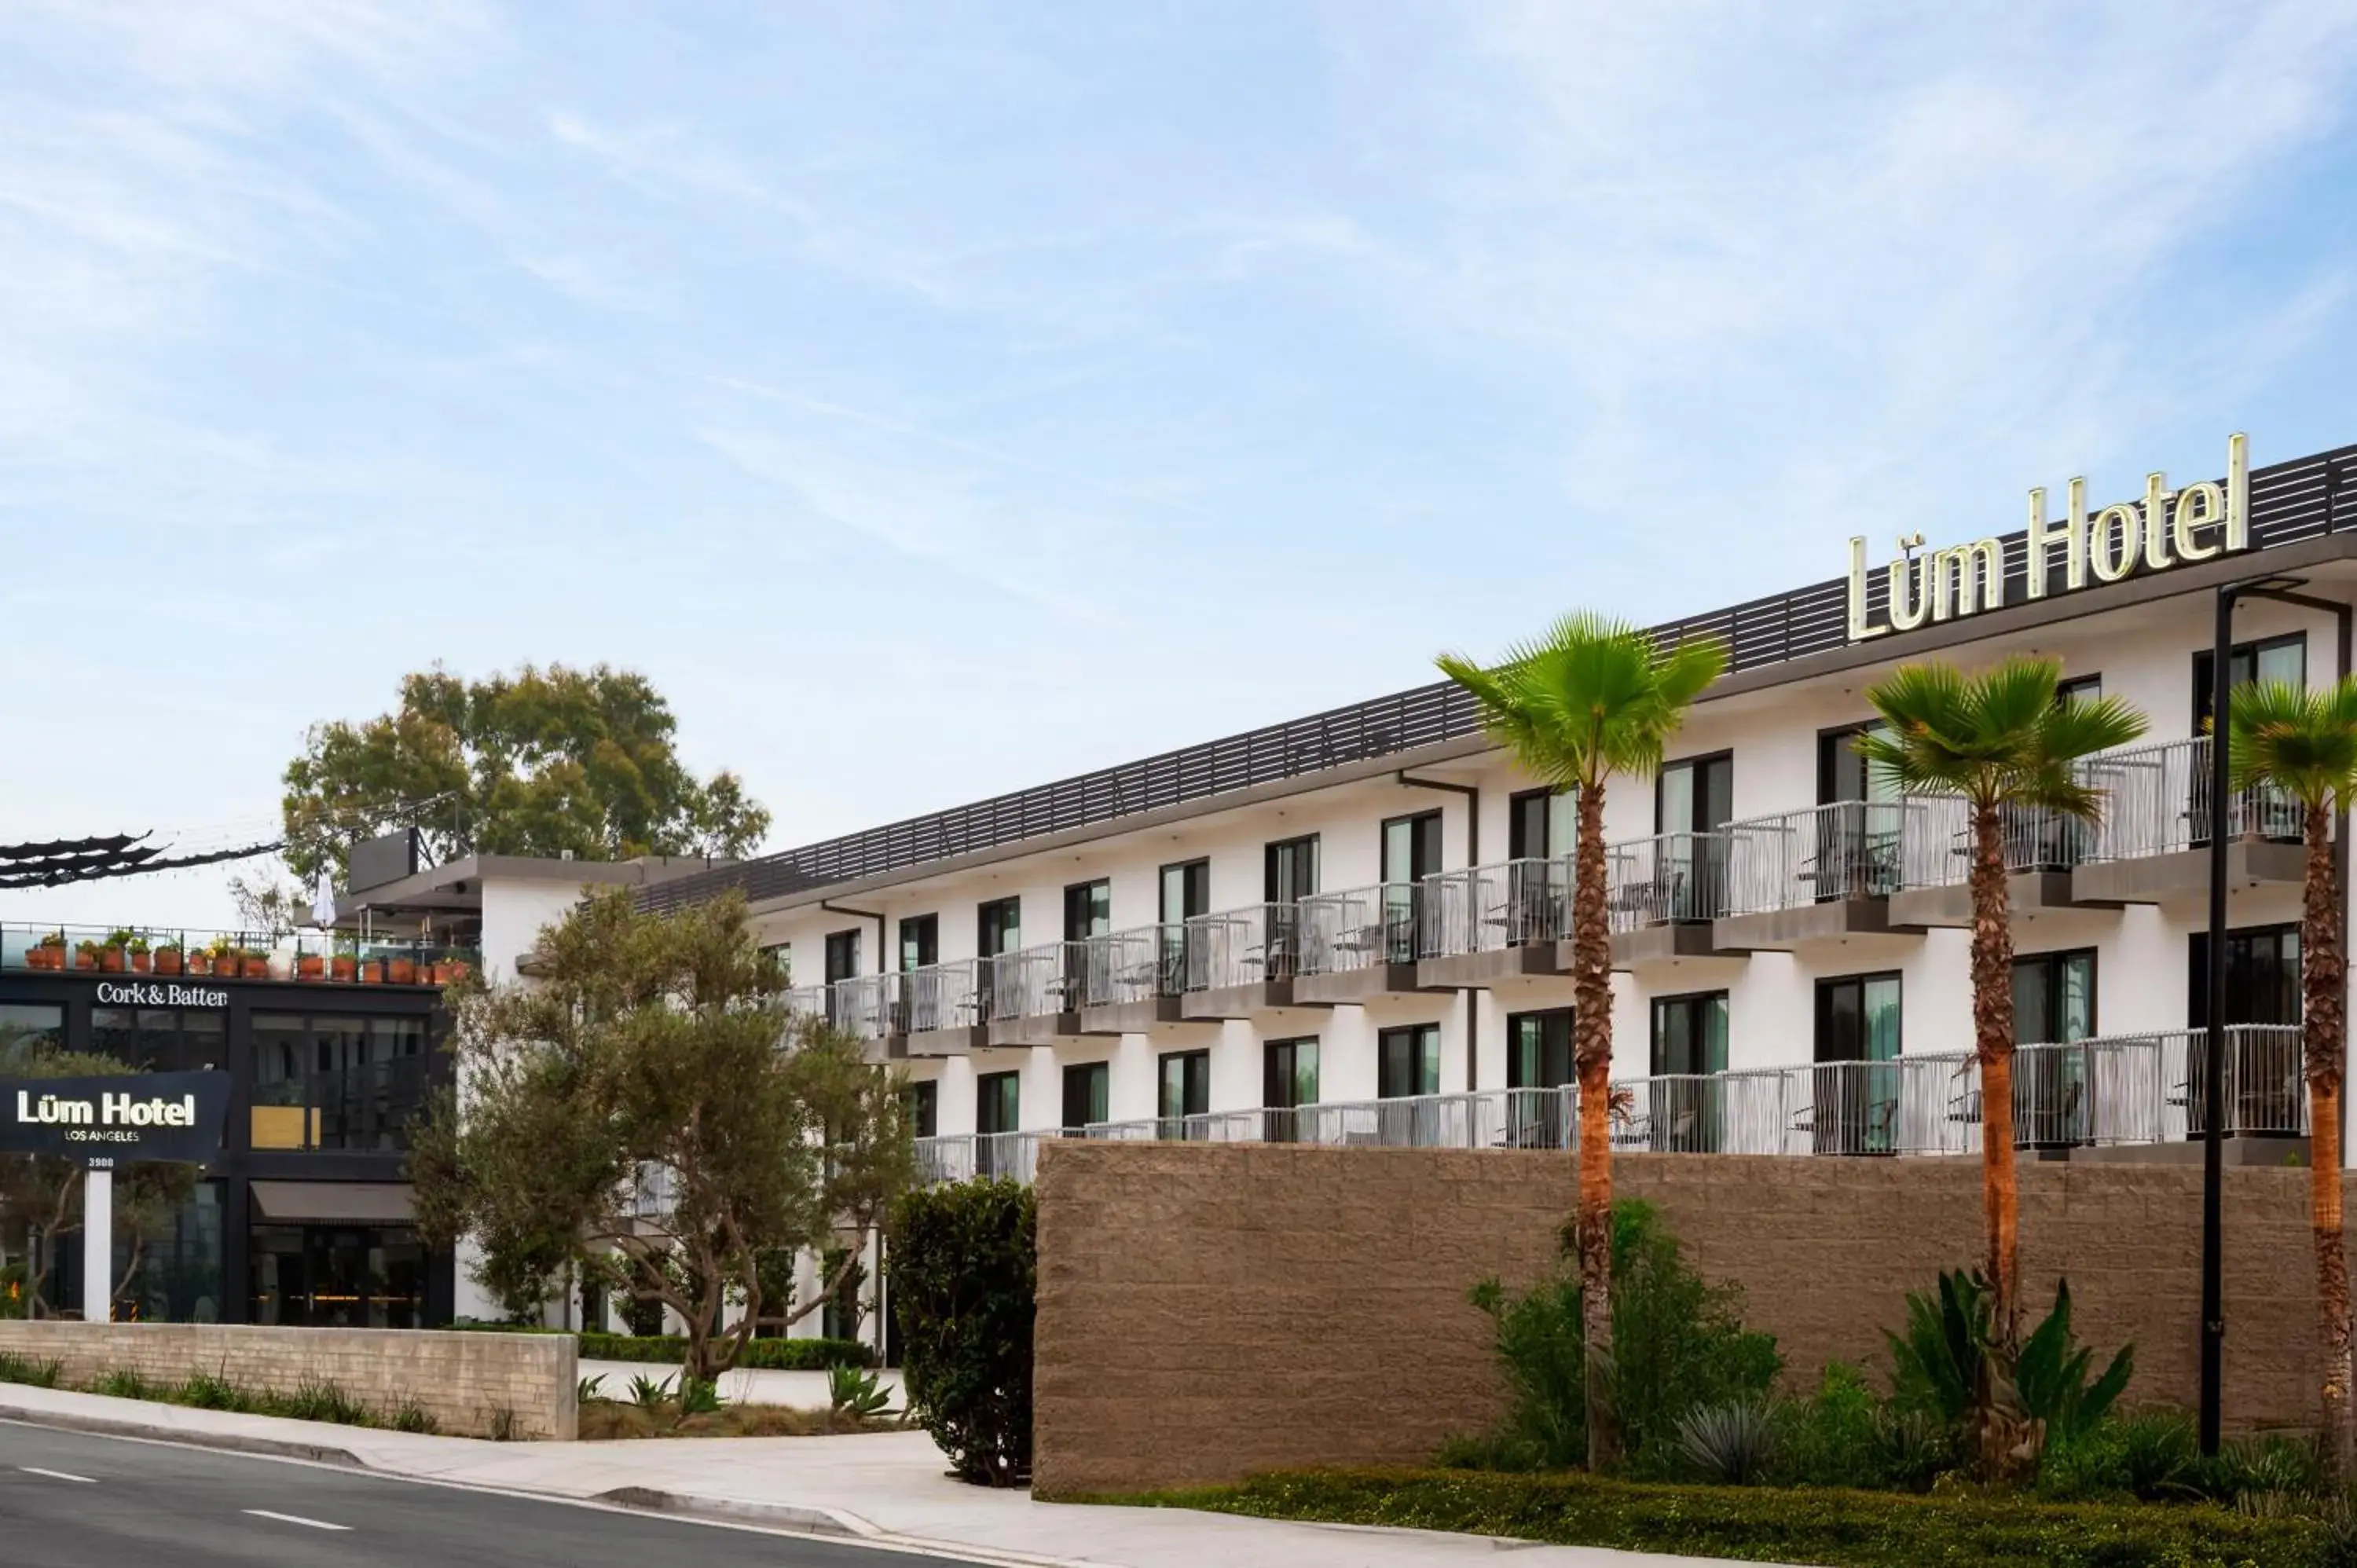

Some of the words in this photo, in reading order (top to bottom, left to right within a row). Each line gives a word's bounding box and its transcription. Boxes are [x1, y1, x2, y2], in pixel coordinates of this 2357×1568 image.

[1849, 529, 2005, 641] Lüm
[2027, 431, 2249, 599] Hotel
[97, 982, 147, 1003] Cork
[148, 984, 165, 1005] &
[167, 984, 228, 1006] Batten
[17, 1090, 93, 1124] Lüm
[102, 1093, 196, 1126] Hotel
[64, 1130, 87, 1141] LOS
[89, 1130, 140, 1142] ANGELES
